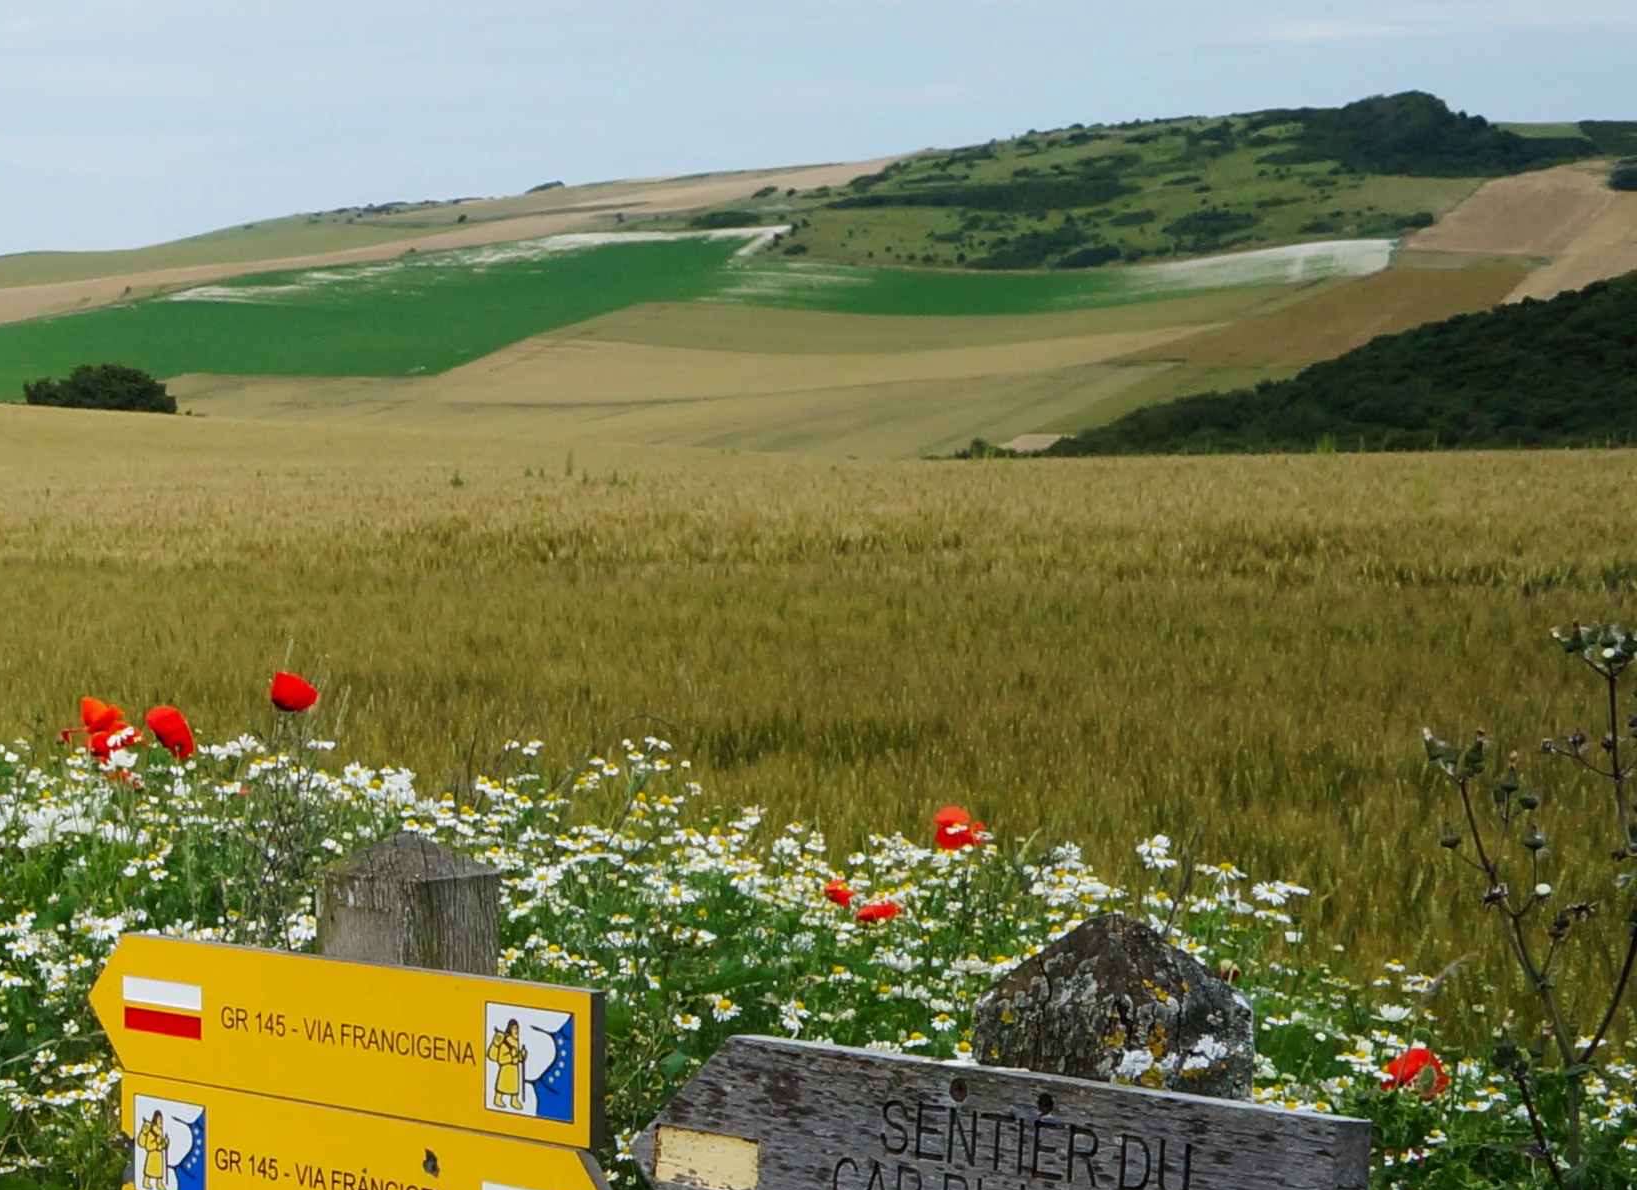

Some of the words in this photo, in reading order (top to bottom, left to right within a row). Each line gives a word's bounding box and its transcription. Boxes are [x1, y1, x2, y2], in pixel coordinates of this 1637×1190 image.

[220, 1005, 249, 1033] GR
[255, 1011, 286, 1037] 145
[302, 1017, 336, 1045] VIA
[340, 1023, 477, 1067] FRANCIGENA
[214, 1147, 242, 1174] GR
[248, 1154, 279, 1181] 145
[294, 1162, 327, 1190] VIA
[879, 1100, 1100, 1189] SENTIER
